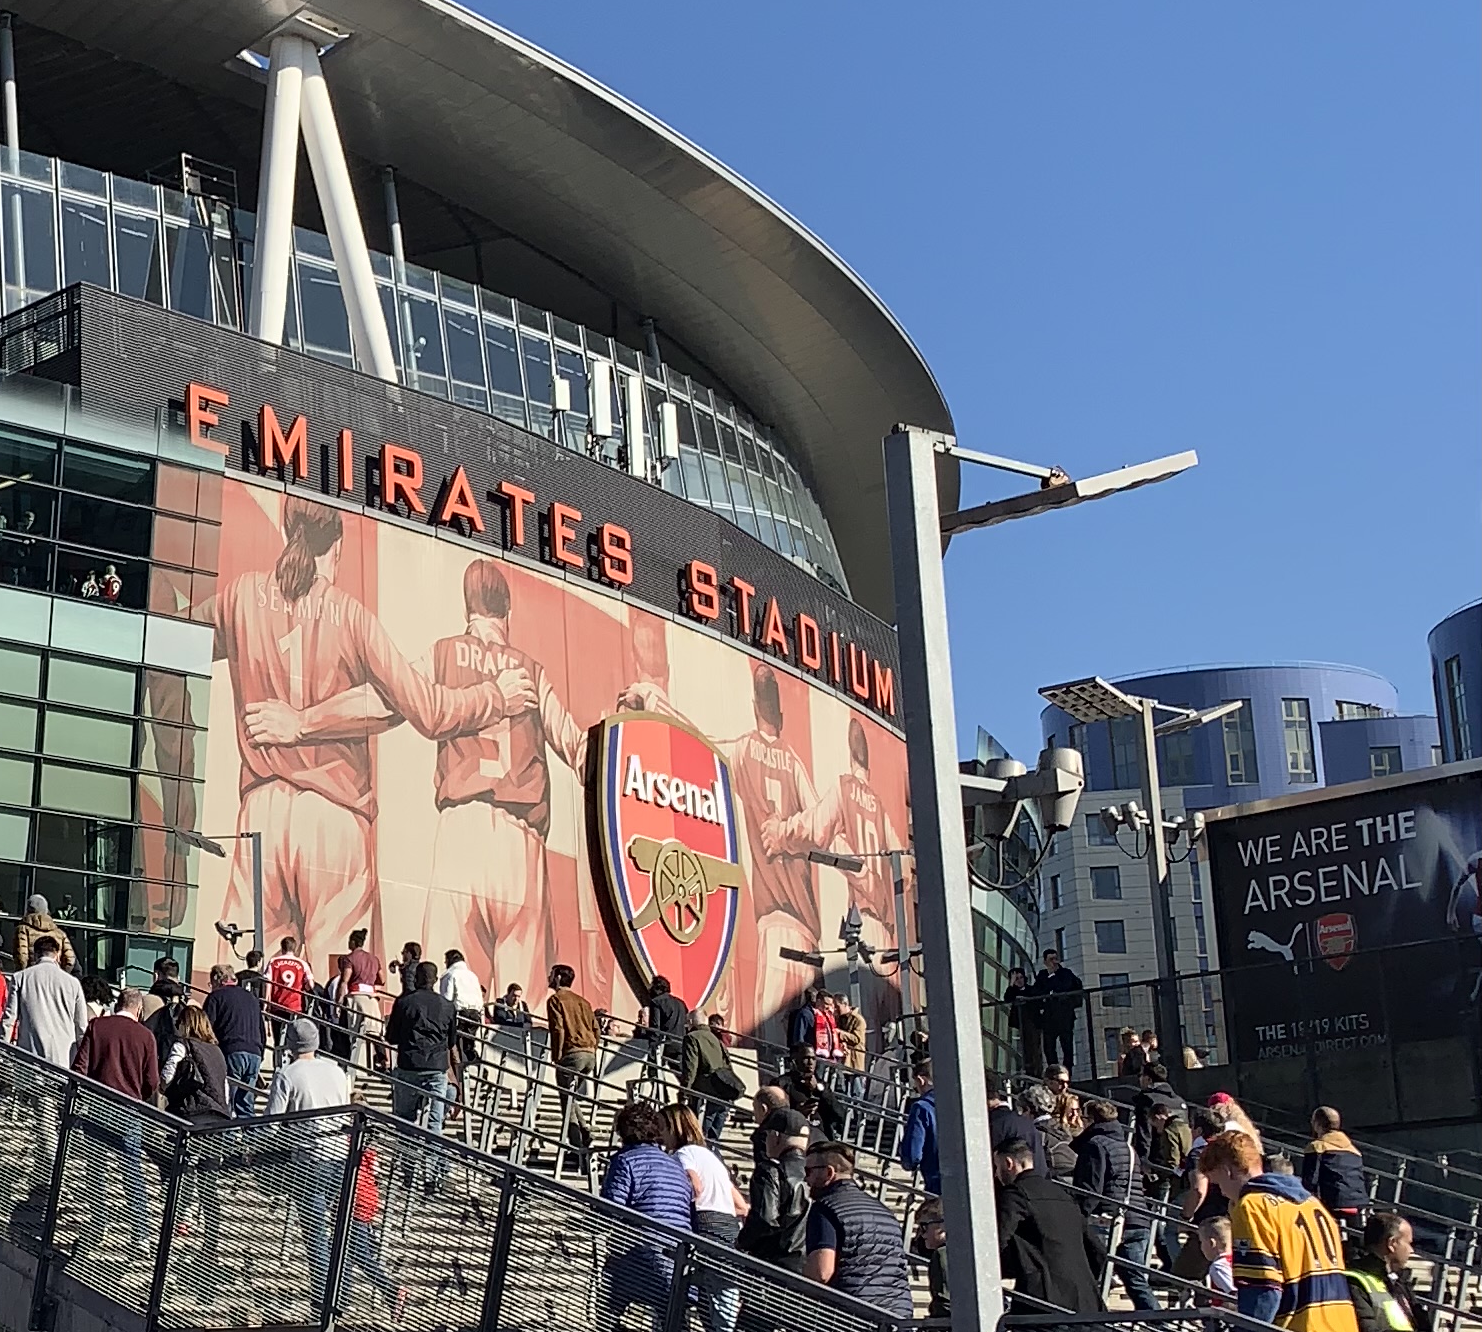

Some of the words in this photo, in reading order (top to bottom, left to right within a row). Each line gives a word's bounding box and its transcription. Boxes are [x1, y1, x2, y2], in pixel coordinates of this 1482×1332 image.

[186, 382, 634, 586] EMIRATES
[687, 560, 895, 716] STADIUM
[257, 583, 340, 627] SEAMAN
[278, 623, 304, 712] 1
[749, 738, 793, 772] ROCASTLE
[625, 754, 726, 826] Arsenal
[1238, 835, 1282, 867] WE
[1291, 823, 1349, 859] ARE
[1356, 810, 1416, 846] THE
[1244, 855, 1423, 915] ARSENAL
[282, 970, 295, 988] 9
[1256, 1023, 1286, 1042] THE
[1294, 1208, 1338, 1269] 10
